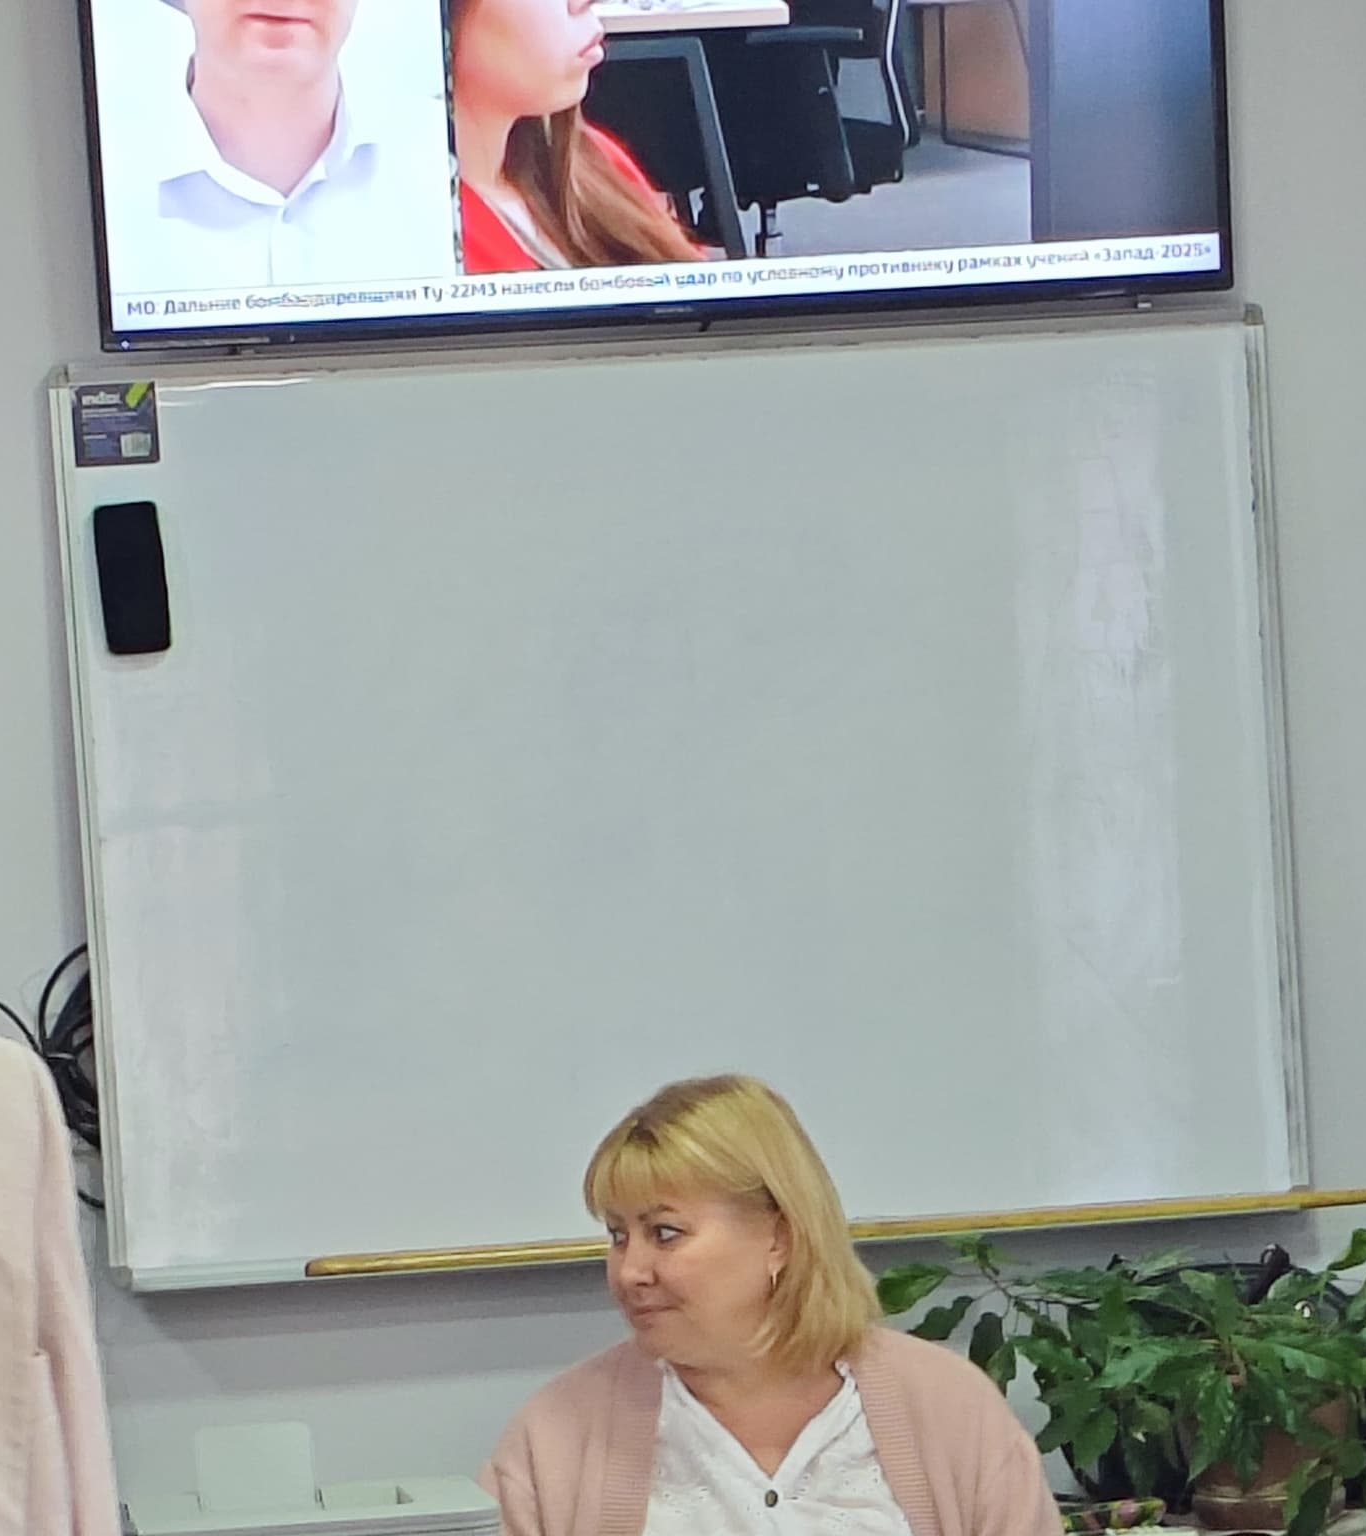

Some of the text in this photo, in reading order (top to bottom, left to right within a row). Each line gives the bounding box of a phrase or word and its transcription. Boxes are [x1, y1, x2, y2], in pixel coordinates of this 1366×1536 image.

[721, 270, 742, 284] по
[848, 257, 954, 280] противнику
[958, 254, 1023, 273] рамках
